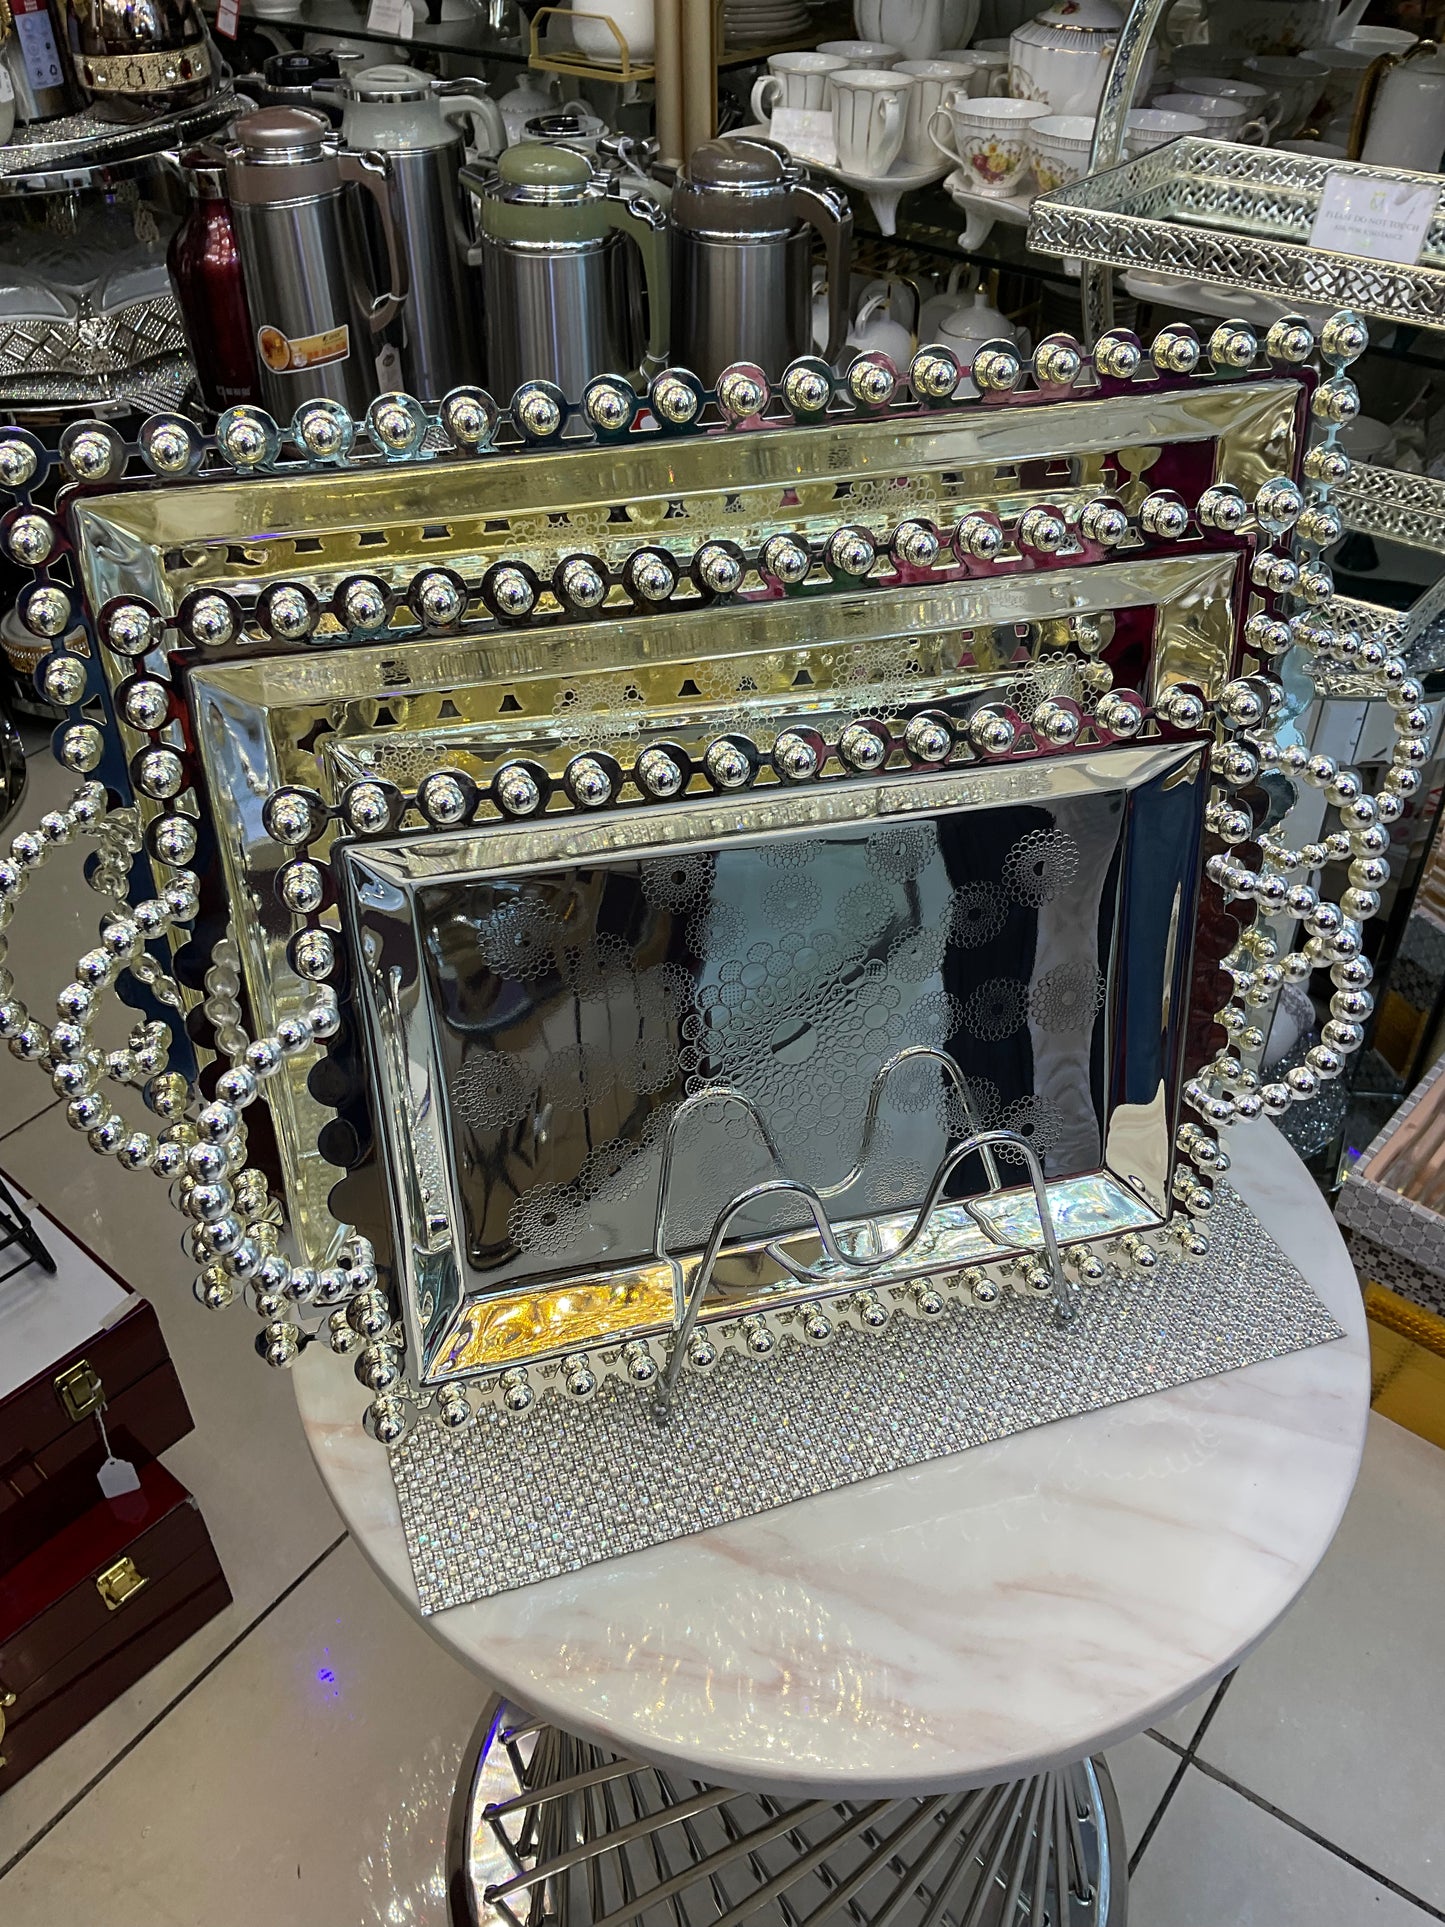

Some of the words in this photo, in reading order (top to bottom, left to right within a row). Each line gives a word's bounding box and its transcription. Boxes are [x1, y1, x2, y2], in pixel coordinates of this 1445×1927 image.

[1325, 211, 1352, 221] PLEASE
[1354, 214, 1367, 224] DO
[1368, 217, 1388, 228] NOT
[1390, 221, 1420, 232] TOUCH
